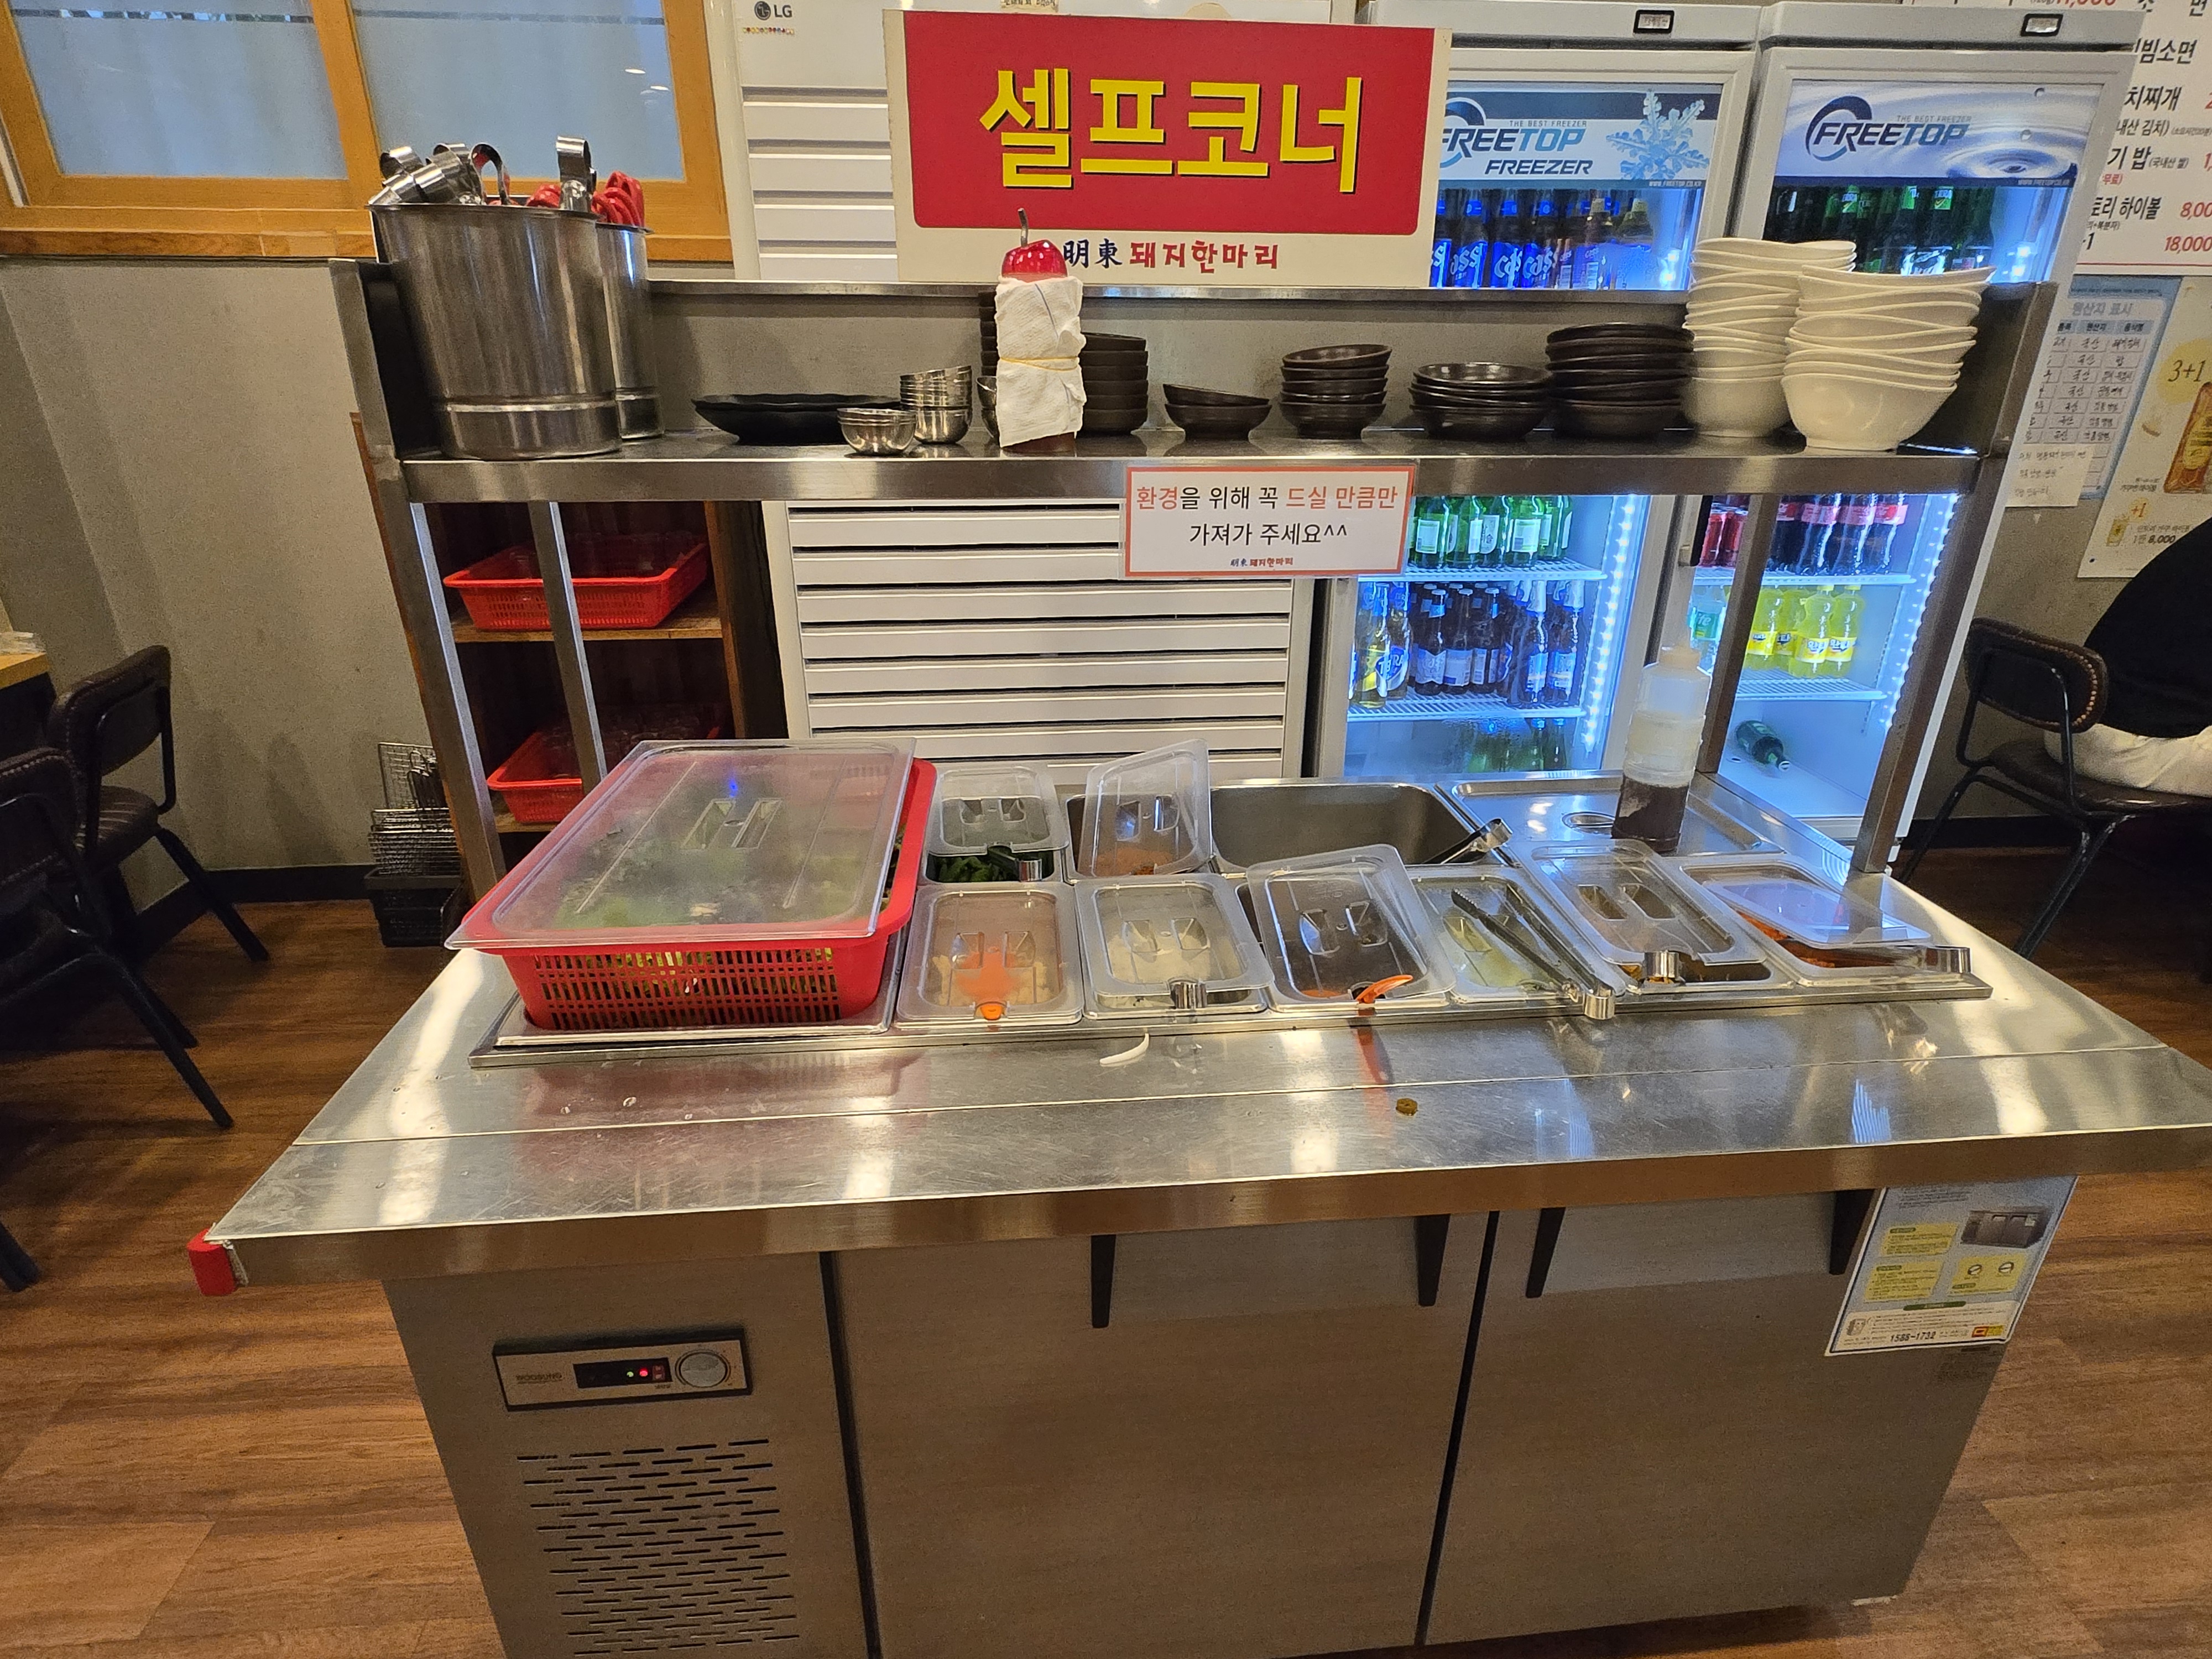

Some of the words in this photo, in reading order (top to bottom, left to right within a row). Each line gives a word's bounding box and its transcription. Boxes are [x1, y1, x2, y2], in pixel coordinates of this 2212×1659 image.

[773, 4, 793, 18] LG
[2124, 85, 2182, 111] 치찌개
[979, 69, 1363, 194] 셀프코너
[1813, 123, 1970, 152] FREETOP
[2141, 119, 2170, 137] 김치)
[1485, 159, 1593, 175] FREEZER
[2119, 196, 2163, 220] 하이볼
[1063, 239, 1123, 267] 明東
[1130, 239, 1279, 275] 돼지한마리
[2168, 359, 2206, 382] 3+1
[1136, 486, 1201, 510] 환경을
[1209, 486, 1250, 510] 위해
[1258, 488, 1279, 509] 꼭
[1286, 486, 1327, 510] 드실
[1335, 486, 1398, 510] 만큼만
[1189, 523, 1253, 546] 가져가
[1259, 523, 1348, 546] 주세요^^
[2148, 535, 2176, 545] 8,000
